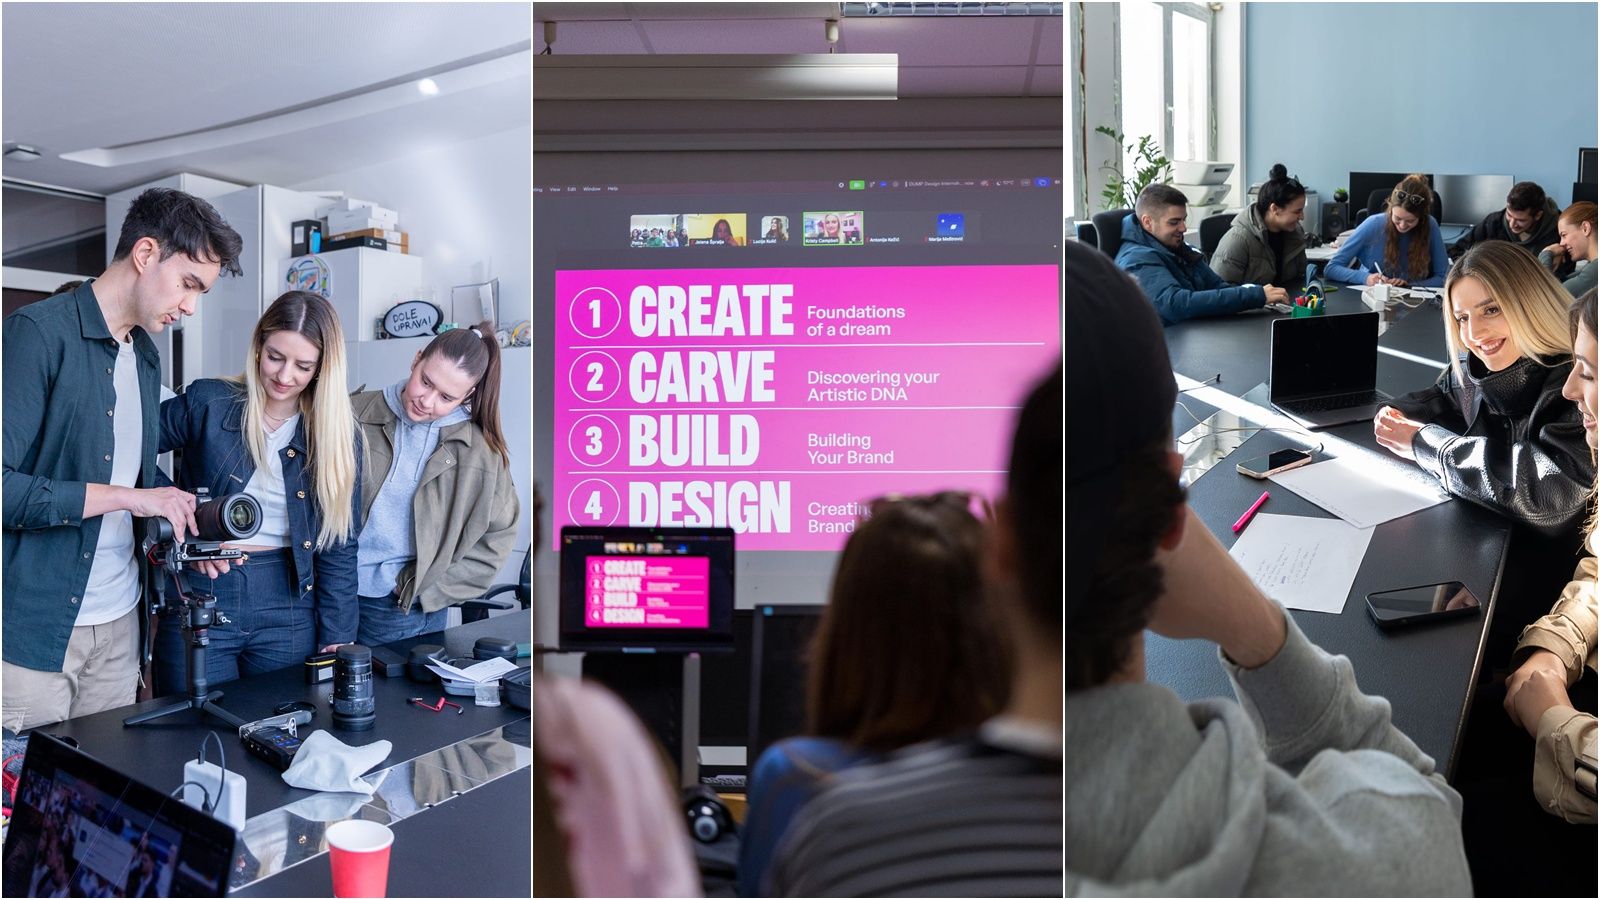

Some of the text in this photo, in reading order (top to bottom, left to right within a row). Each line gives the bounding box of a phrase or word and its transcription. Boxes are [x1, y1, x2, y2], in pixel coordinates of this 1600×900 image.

[392, 308, 418, 323] DOLE
[588, 284, 795, 338] 1 CREATE
[807, 304, 906, 320] Foundations
[393, 315, 432, 332] UPRAVA!
[806, 322, 891, 337] of a dream
[586, 350, 776, 404] 2 CARVE
[807, 370, 940, 387] Discovering your
[807, 387, 908, 402] Artistic DNA
[585, 414, 760, 467] 3 BUILD
[808, 433, 872, 450] Building
[807, 450, 894, 465] Your Brand
[584, 480, 791, 534] 4 DESIGN
[808, 519, 856, 533] Brand
[603, 560, 647, 576] CREATE
[603, 576, 642, 592] CARVE
[603, 592, 638, 608] BUILD
[603, 608, 646, 624] DESIGN
